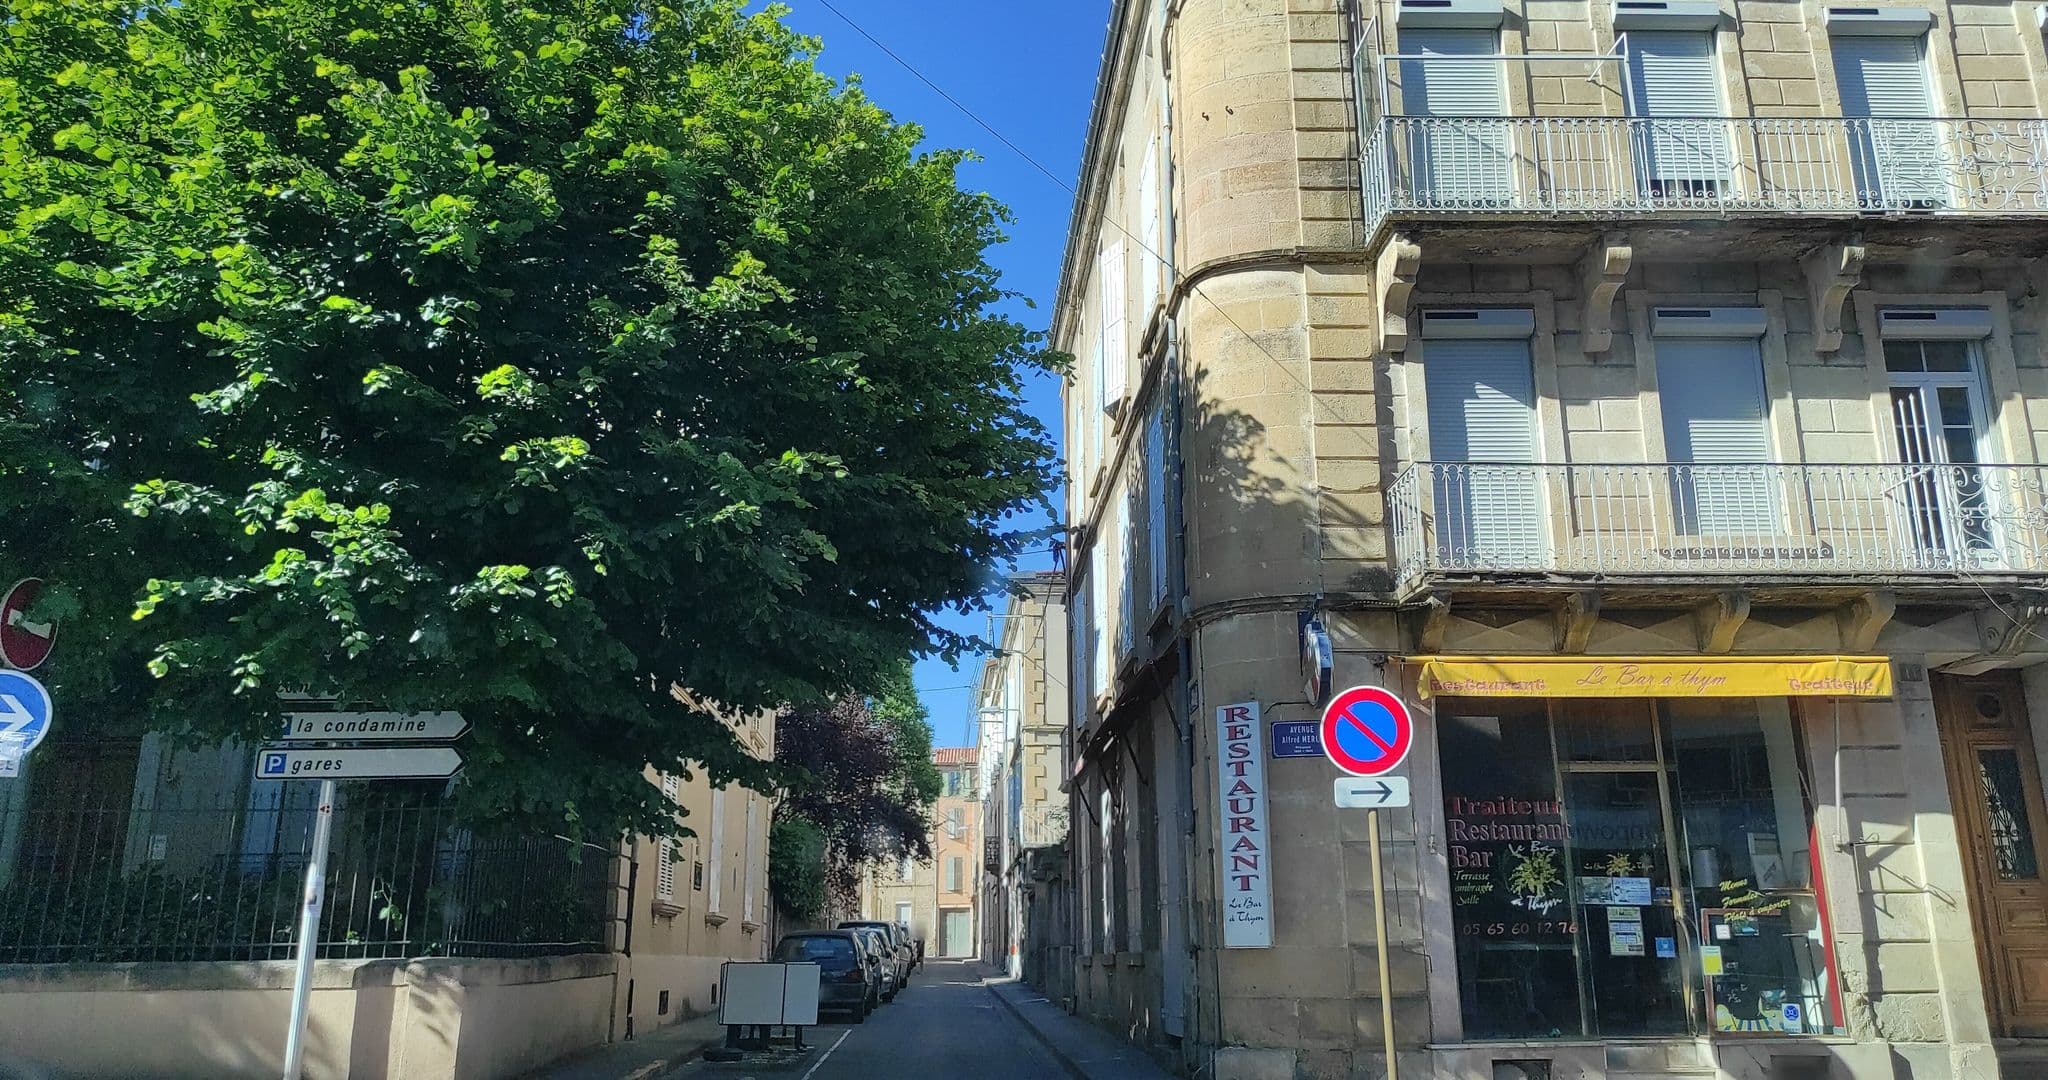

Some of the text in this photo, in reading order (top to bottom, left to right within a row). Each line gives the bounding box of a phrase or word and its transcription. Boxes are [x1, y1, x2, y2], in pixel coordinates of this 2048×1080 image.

[1577, 664, 1608, 686] Le
[1616, 664, 1654, 686] Bar
[1681, 667, 1727, 694] thym
[297, 718, 313, 733] la
[324, 718, 426, 733] condamine
[1302, 735, 1320, 743] MERL
[291, 758, 343, 775] gares
[1223, 706, 1260, 892] RESTAURANT
[1452, 795, 1561, 816] Traiteur
[1448, 819, 1571, 841] Restaurant
[1450, 845, 1493, 868] Bar
[1229, 896, 1262, 909] Le Bar
[1237, 911, 1264, 925] Thym
[1463, 921, 1578, 935] 05 65 60 12 76
